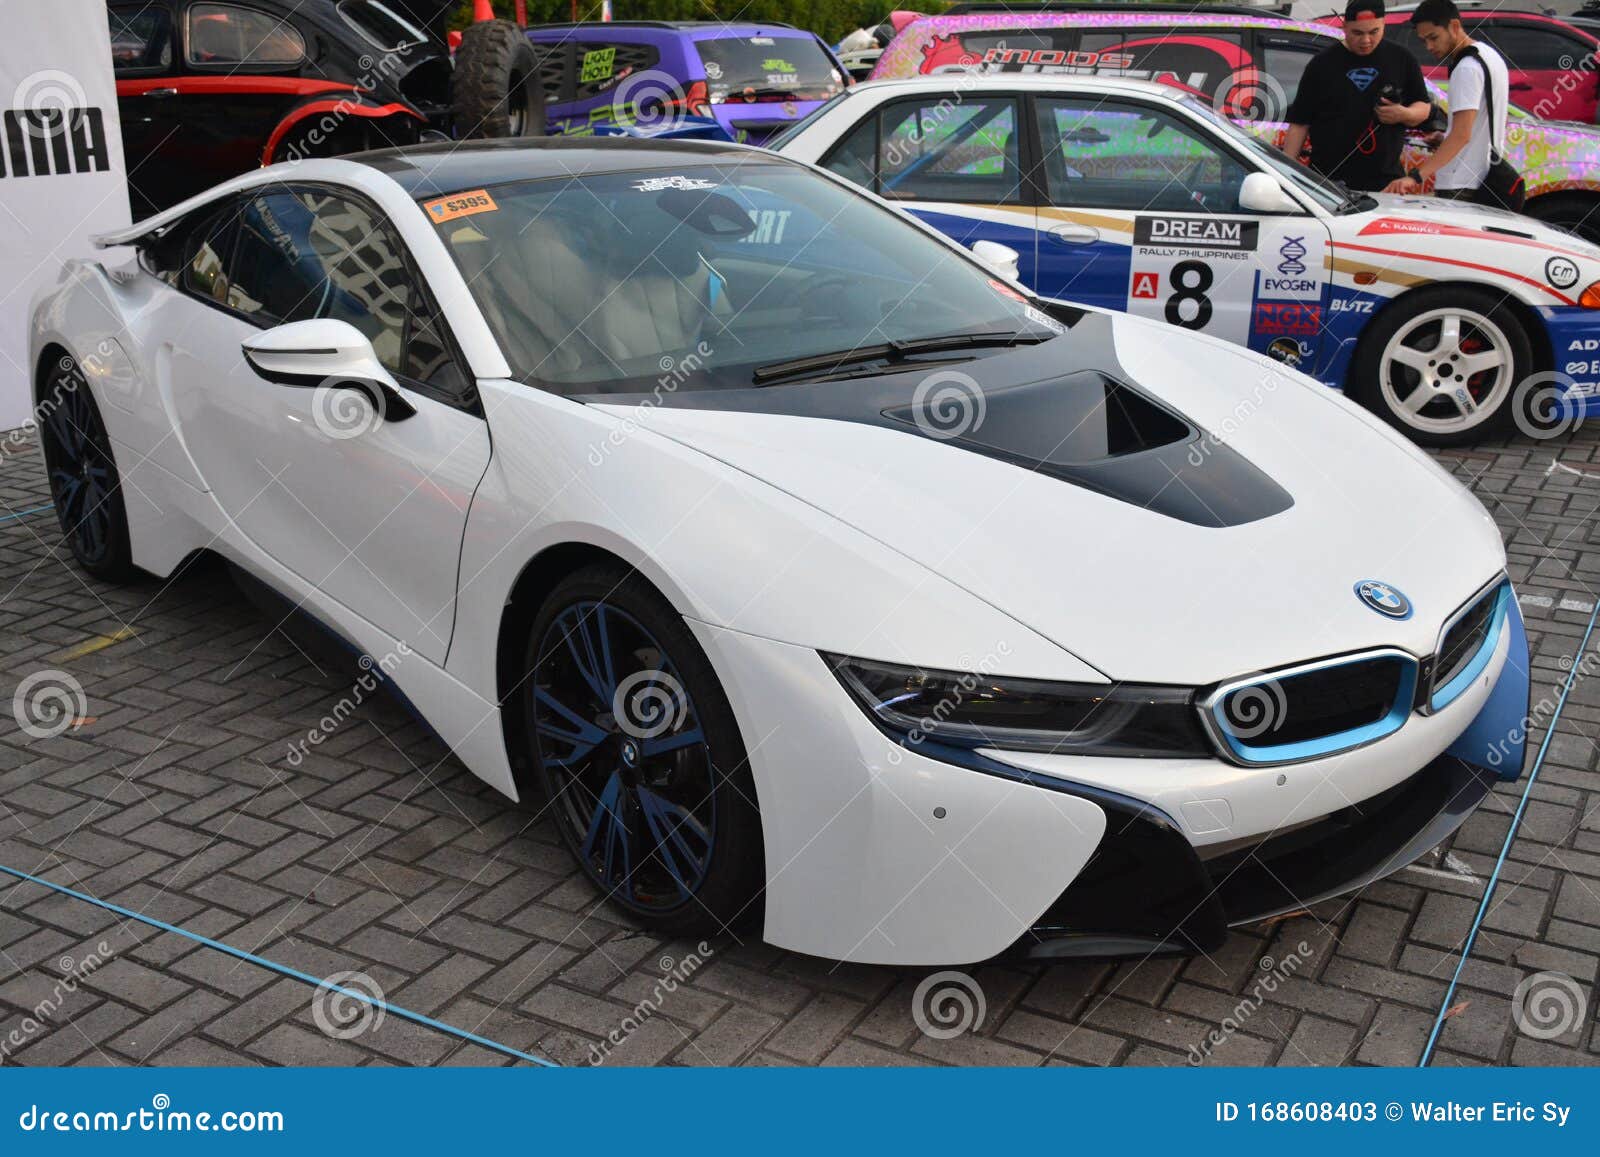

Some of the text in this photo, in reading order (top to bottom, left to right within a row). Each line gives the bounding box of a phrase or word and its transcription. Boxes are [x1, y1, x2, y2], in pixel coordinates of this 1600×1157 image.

[0, 107, 110, 178] MA
[446, 195, 489, 212] S395
[1151, 219, 1241, 240] DREAM
[1139, 247, 1249, 260] RALLY PHILIPPINES
[1135, 275, 1155, 296] A
[1165, 259, 1214, 331] 8
[1265, 279, 1316, 291] EVOGEN
[1259, 305, 1320, 327] NGK
[1568, 339, 1600, 351] AD
